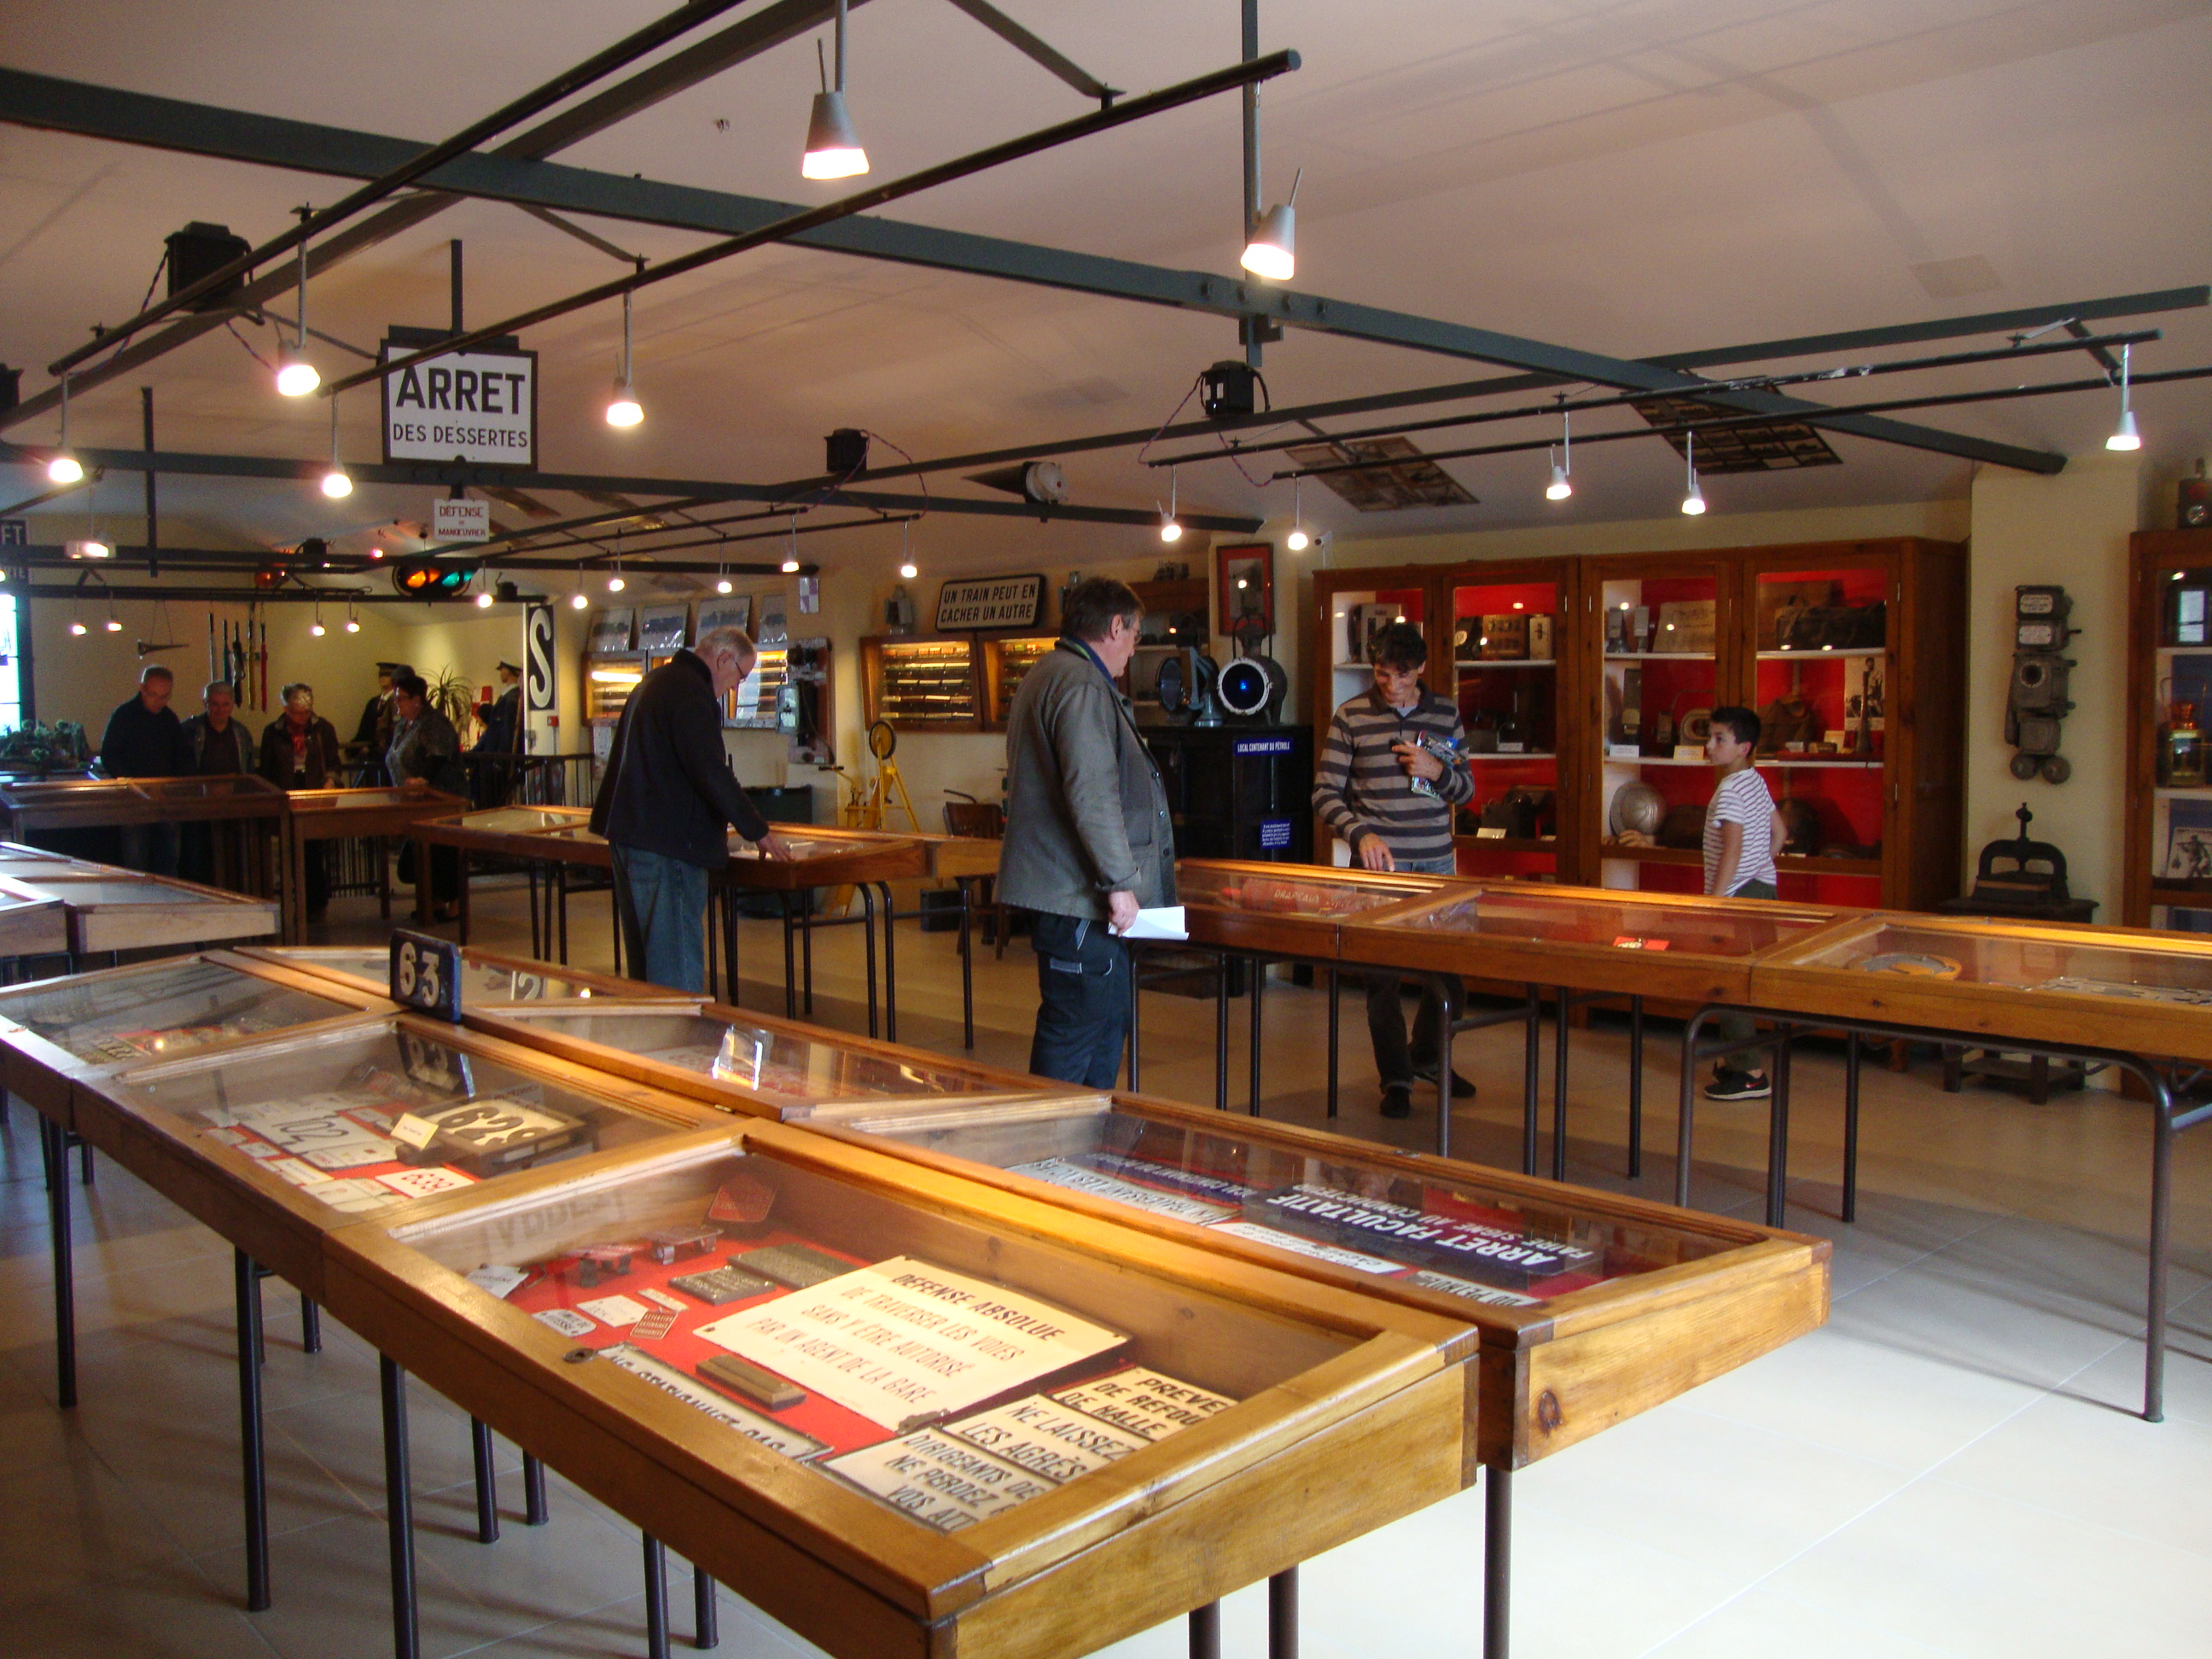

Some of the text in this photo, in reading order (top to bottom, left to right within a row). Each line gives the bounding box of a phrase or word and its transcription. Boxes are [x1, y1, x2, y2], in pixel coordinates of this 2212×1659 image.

[396, 364, 525, 415] ARRET
[393, 423, 527, 448] DES DESSERTES
[944, 583, 1036, 603] UN TRAIN PEUT EN
[940, 603, 1033, 623] CACHER UN AUTRE
[529, 608, 553, 708] S
[399, 941, 441, 1008] 63
[1266, 1193, 1444, 1242] FACULTATIF
[1417, 1213, 1455, 1225] AU
[1453, 1221, 1524, 1243] SIGNE
[1432, 1236, 1558, 1267] ARRET
[800, 1303, 850, 1325] SANS
[844, 1317, 859, 1331] Y
[841, 1285, 1025, 1363] DE TRAVERSER LES VOIES
[969, 1301, 1066, 1342] ABSOLUE
[746, 1317, 937, 1404] PAR UN AGENT DE LA GARE
[1058, 1391, 1098, 1408] DE
[1091, 1382, 1132, 1398] DE
[958, 1422, 1013, 1447] LES
[1004, 1404, 1140, 1463] NE LAISSEZ
[901, 1434, 1014, 1486] DIRIGEANTS
[883, 1454, 1000, 1509] NE PERDEZ
[885, 1484, 937, 1511] VOS
